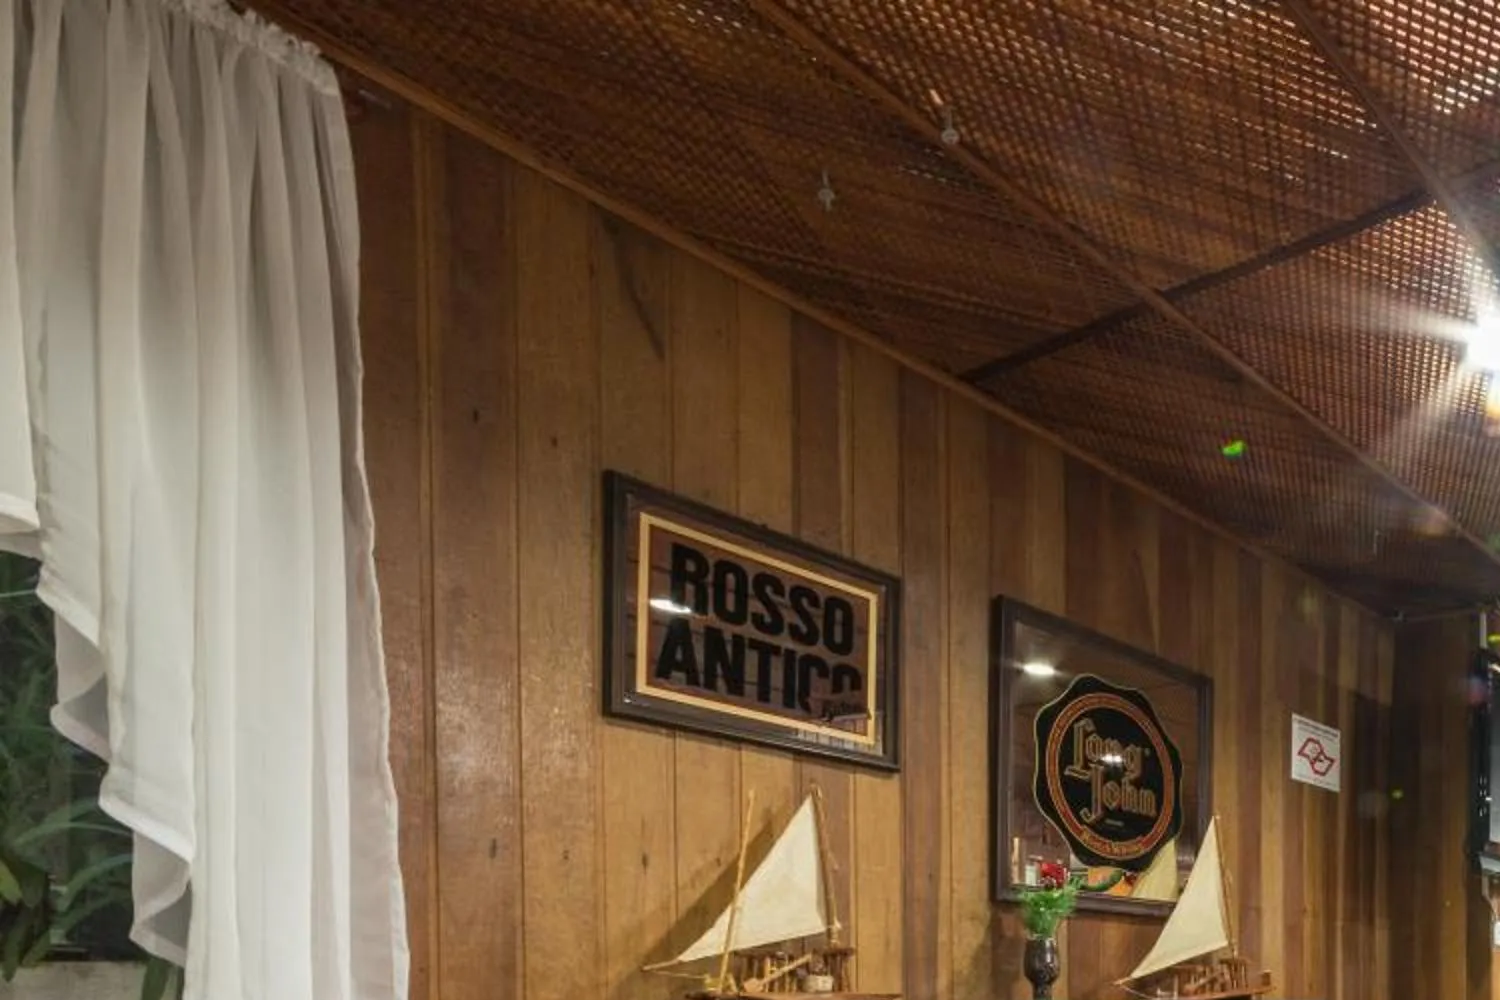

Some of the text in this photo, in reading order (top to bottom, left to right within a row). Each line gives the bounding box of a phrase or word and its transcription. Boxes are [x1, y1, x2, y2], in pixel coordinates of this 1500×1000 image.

[671, 542, 854, 656] ROSSO
[1065, 718, 1144, 781] Long
[1080, 763, 1158, 824] John
